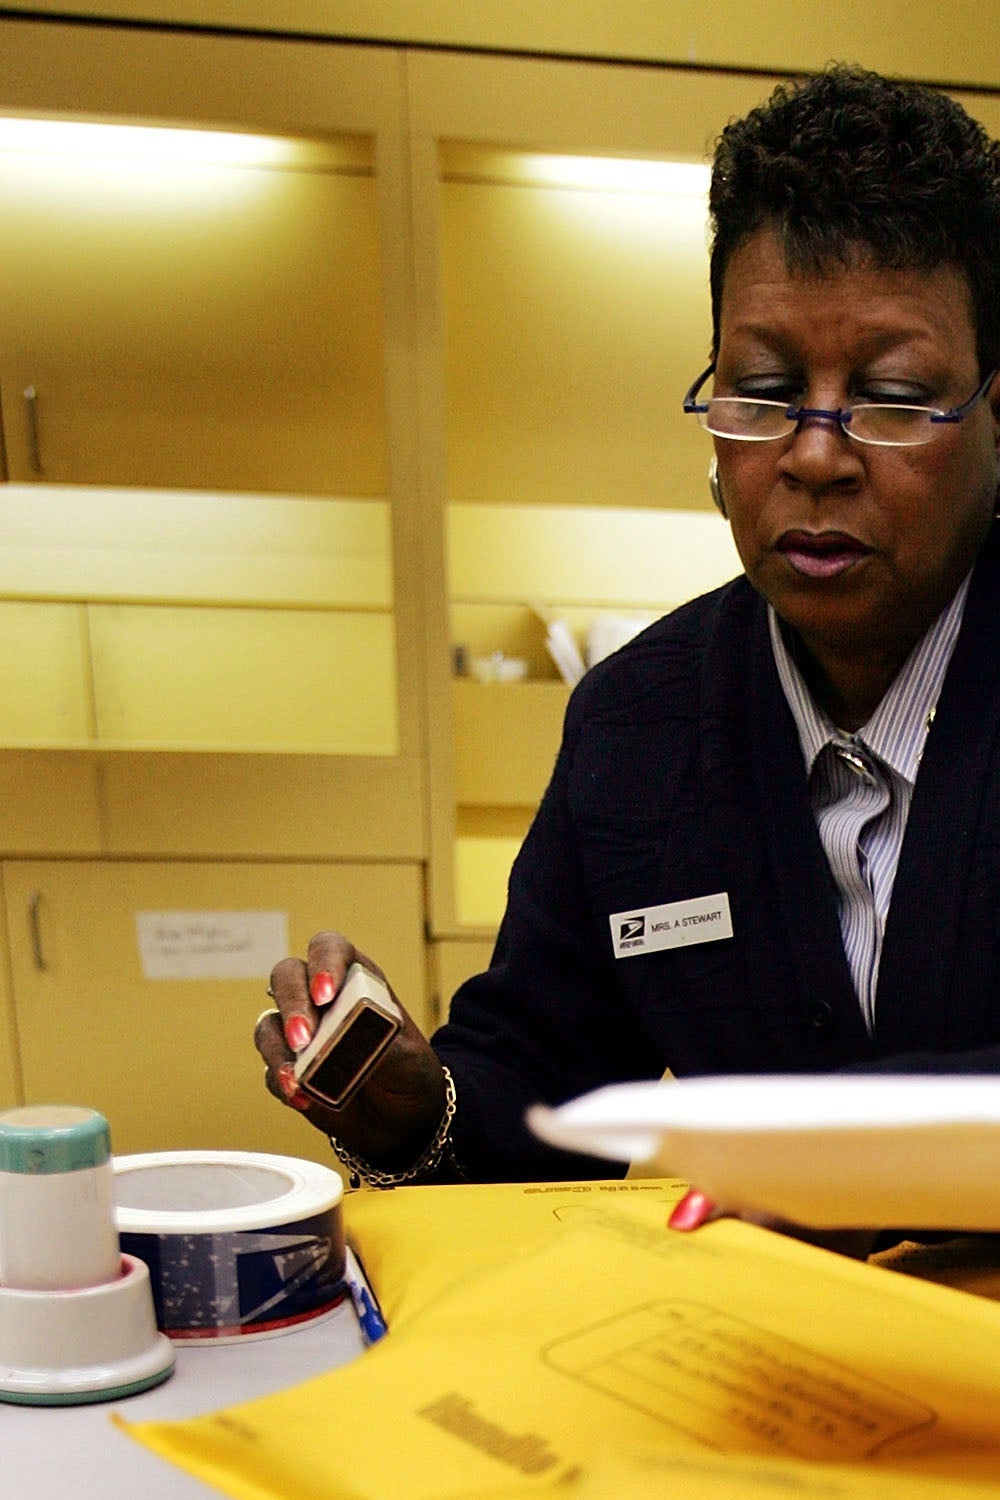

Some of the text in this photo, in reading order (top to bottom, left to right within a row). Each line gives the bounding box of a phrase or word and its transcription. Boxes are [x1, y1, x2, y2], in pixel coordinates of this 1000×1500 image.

[651, 911, 722, 933] MRS. A STEWART
